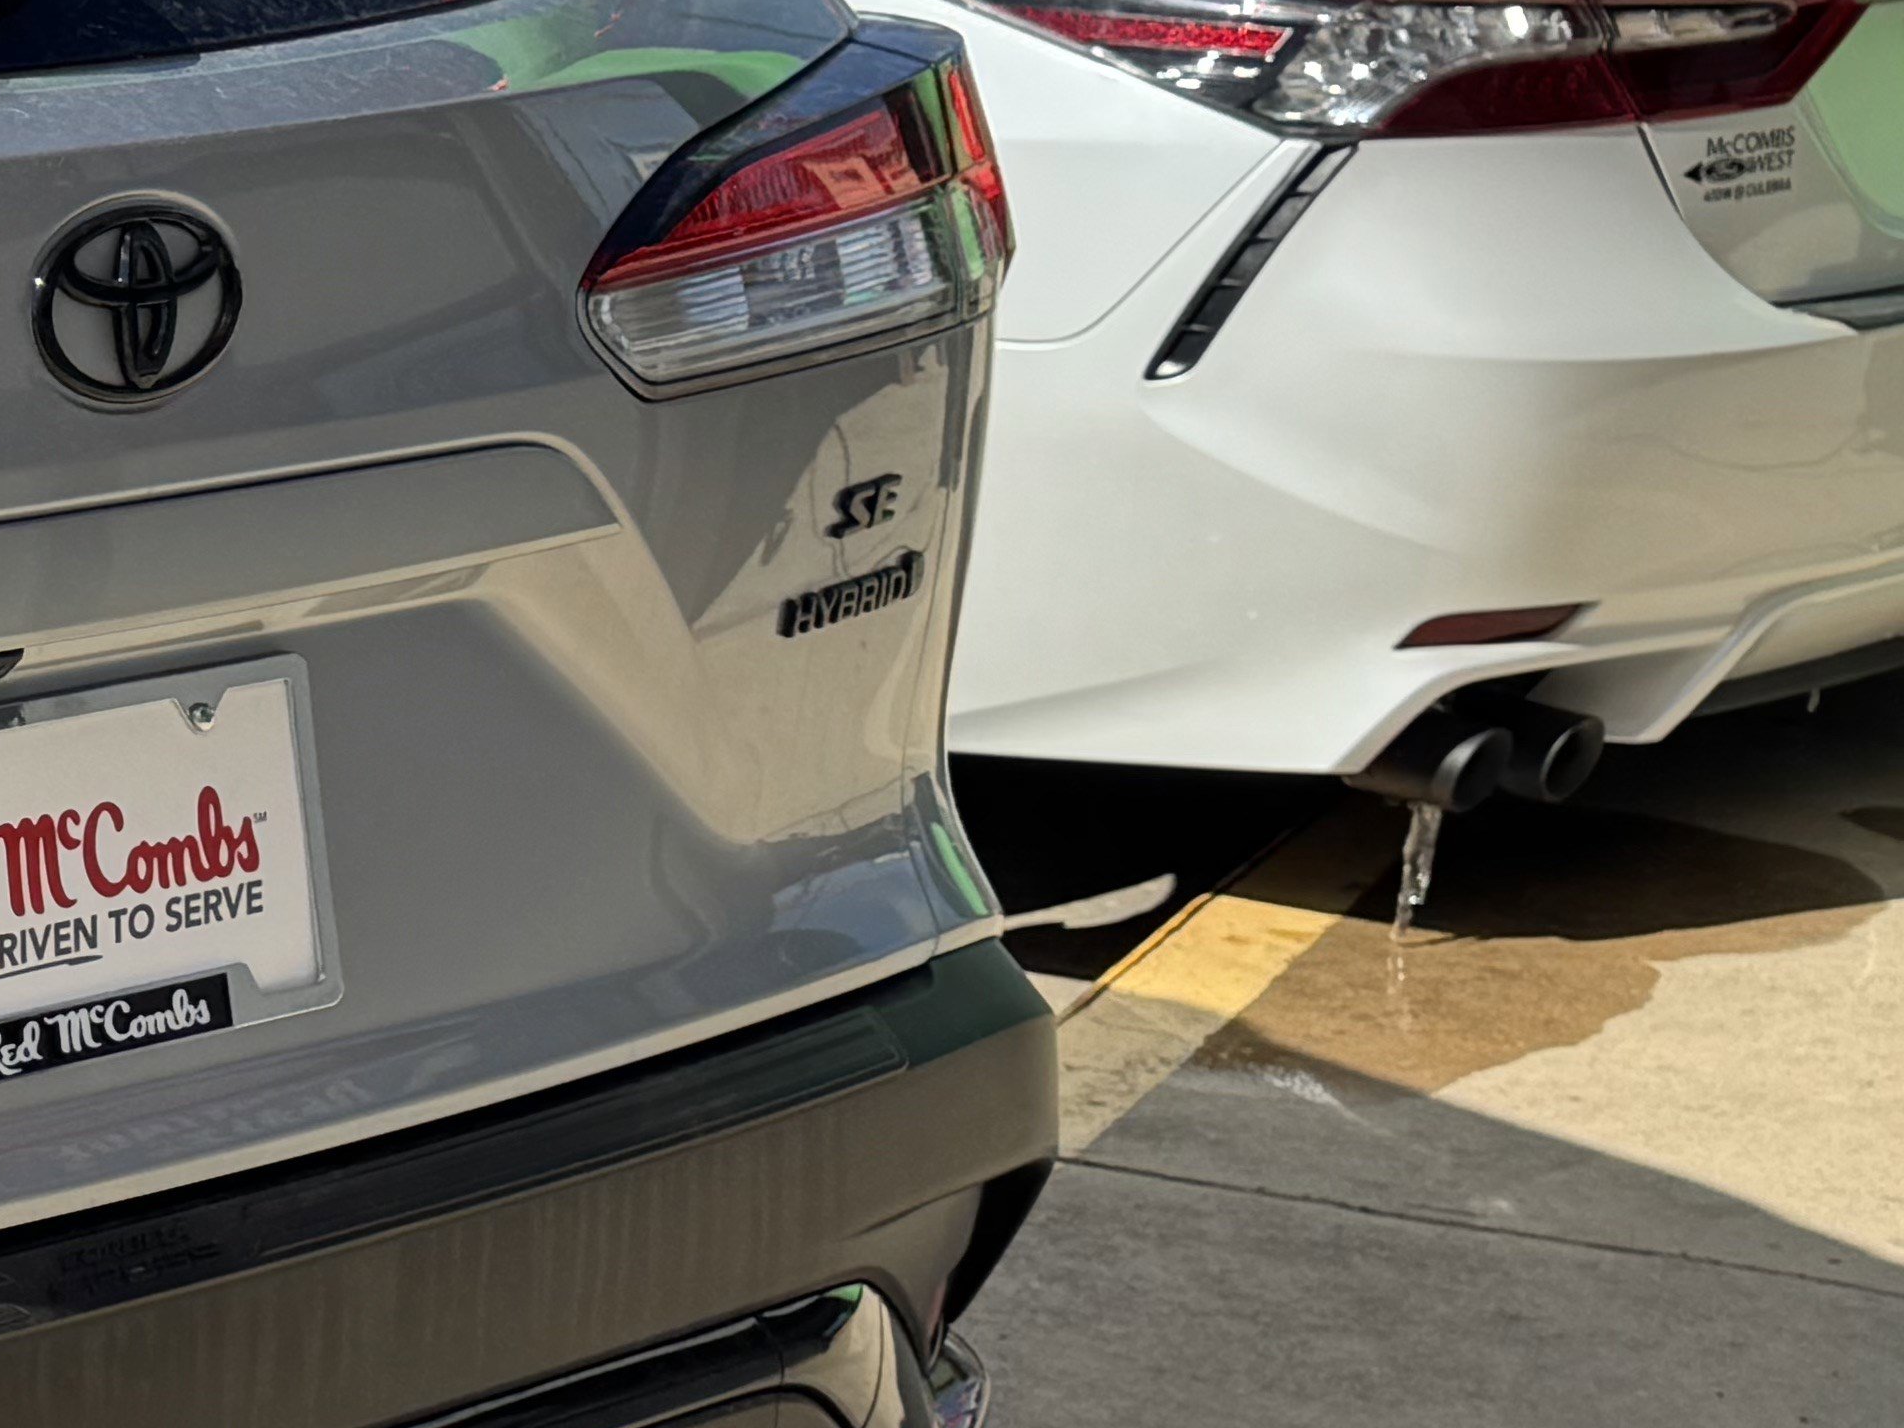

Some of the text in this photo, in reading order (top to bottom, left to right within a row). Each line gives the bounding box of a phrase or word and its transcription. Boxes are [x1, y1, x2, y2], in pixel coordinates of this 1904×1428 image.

[824, 473, 903, 539] SE
[776, 549, 925, 639] HYBRID
[107, 903, 156, 945] TO
[164, 879, 264, 933] SERVE
[43, 988, 212, 1055] McCombs
